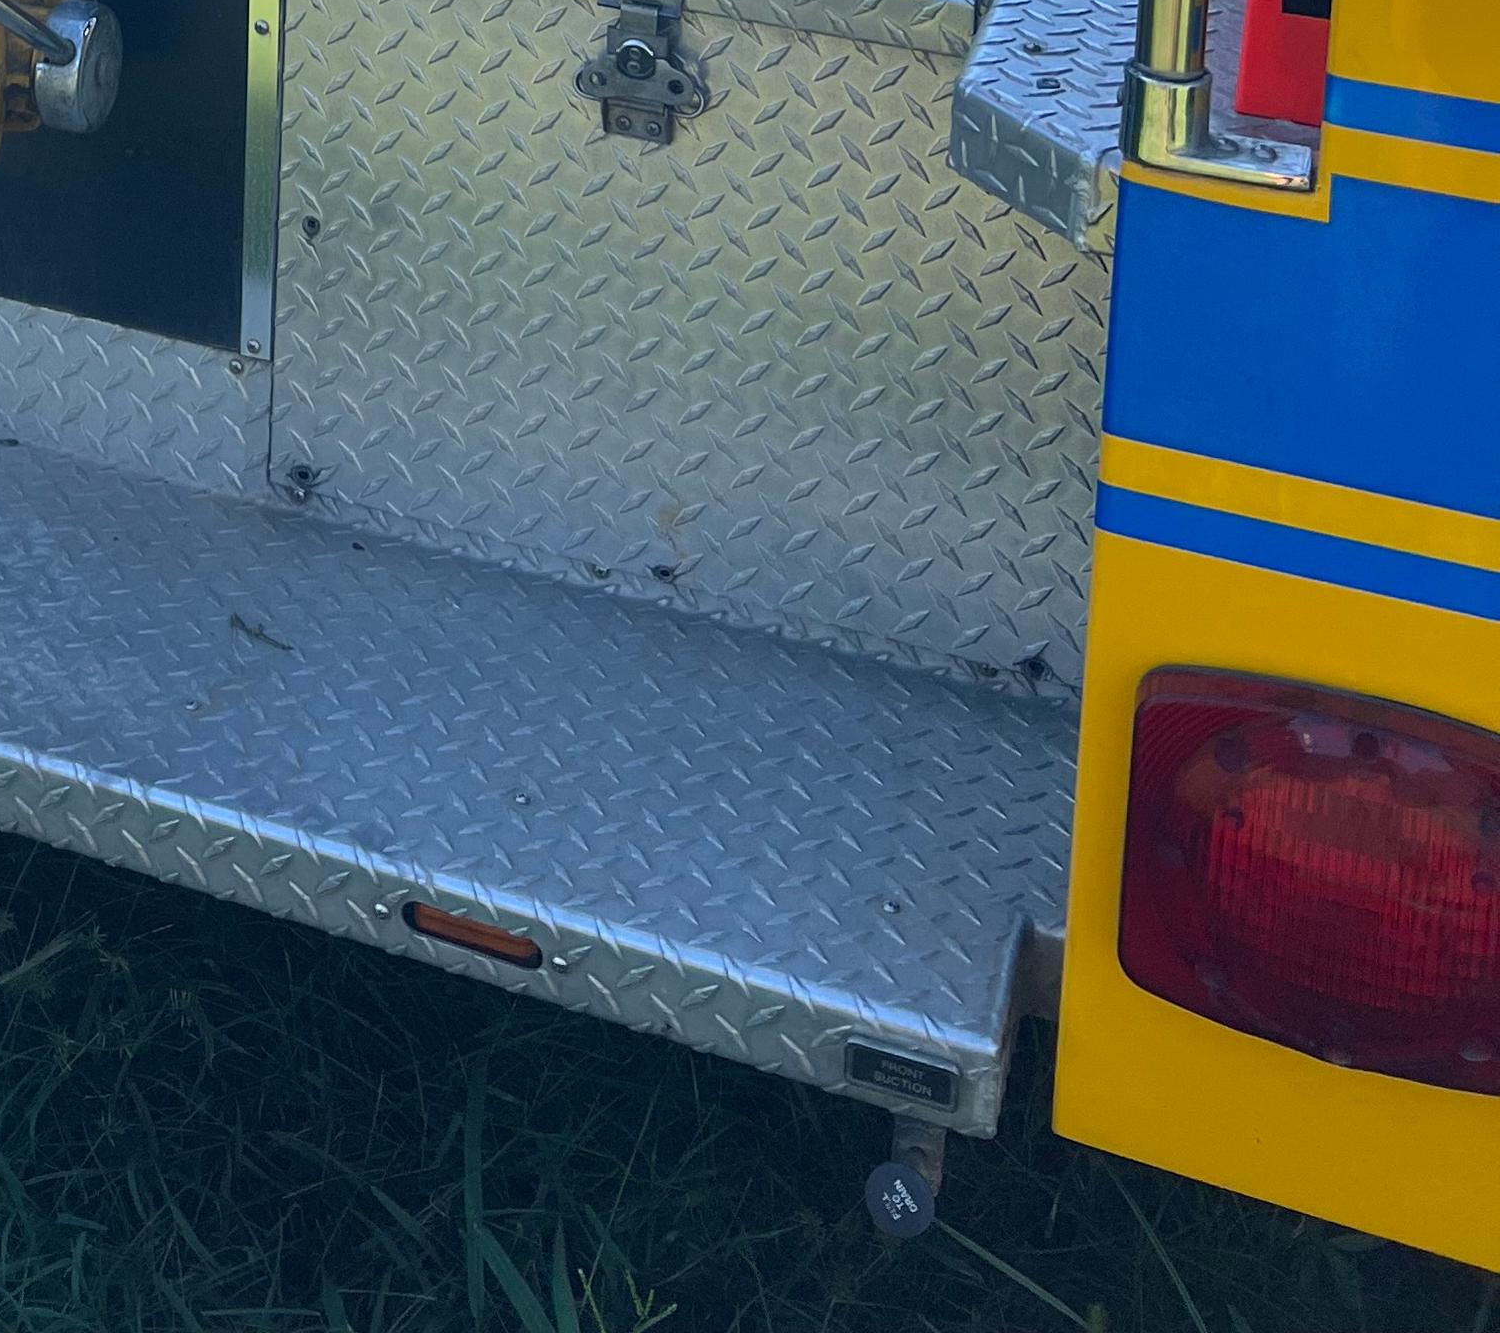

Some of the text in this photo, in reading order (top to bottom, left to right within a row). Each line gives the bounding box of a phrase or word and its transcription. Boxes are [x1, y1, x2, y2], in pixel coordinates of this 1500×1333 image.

[881, 1059, 924, 1081] FRONT
[874, 1070, 933, 1097] SUCTION
[892, 1194, 904, 1210] TO
[894, 1179, 918, 1213] DRAIN
